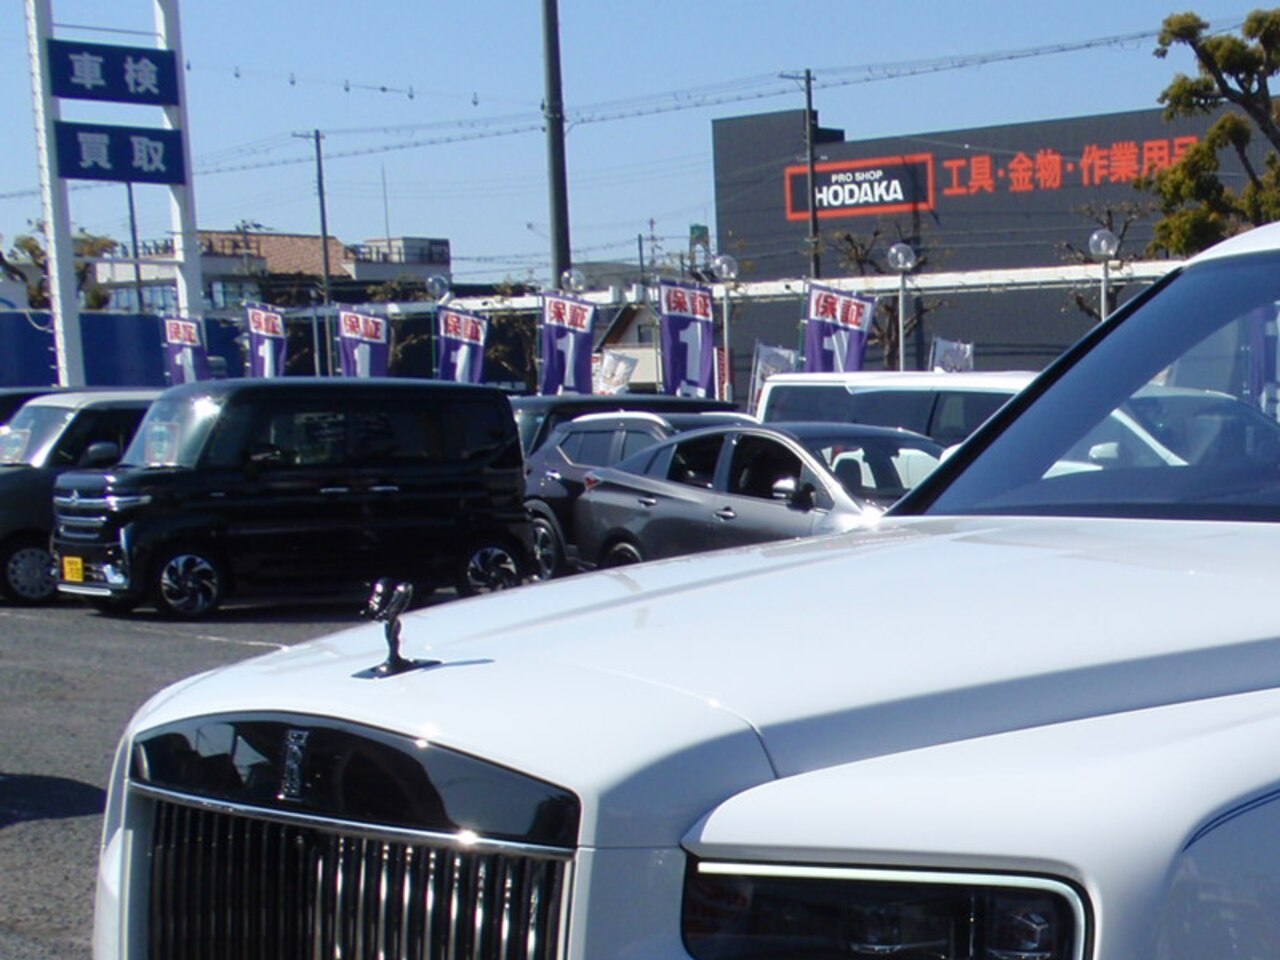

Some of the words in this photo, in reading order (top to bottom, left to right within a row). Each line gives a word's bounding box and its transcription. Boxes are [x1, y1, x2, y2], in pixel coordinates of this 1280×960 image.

[68, 51, 159, 94] 車検
[77, 132, 166, 173] 買取
[831, 173, 853, 184] PRO
[855, 169, 883, 182] SHOP
[815, 179, 904, 208] HODAKA
[550, 300, 589, 330] 保証
[665, 288, 712, 318] 保証
[815, 293, 864, 327] 保証
[444, 314, 482, 342] 保証
